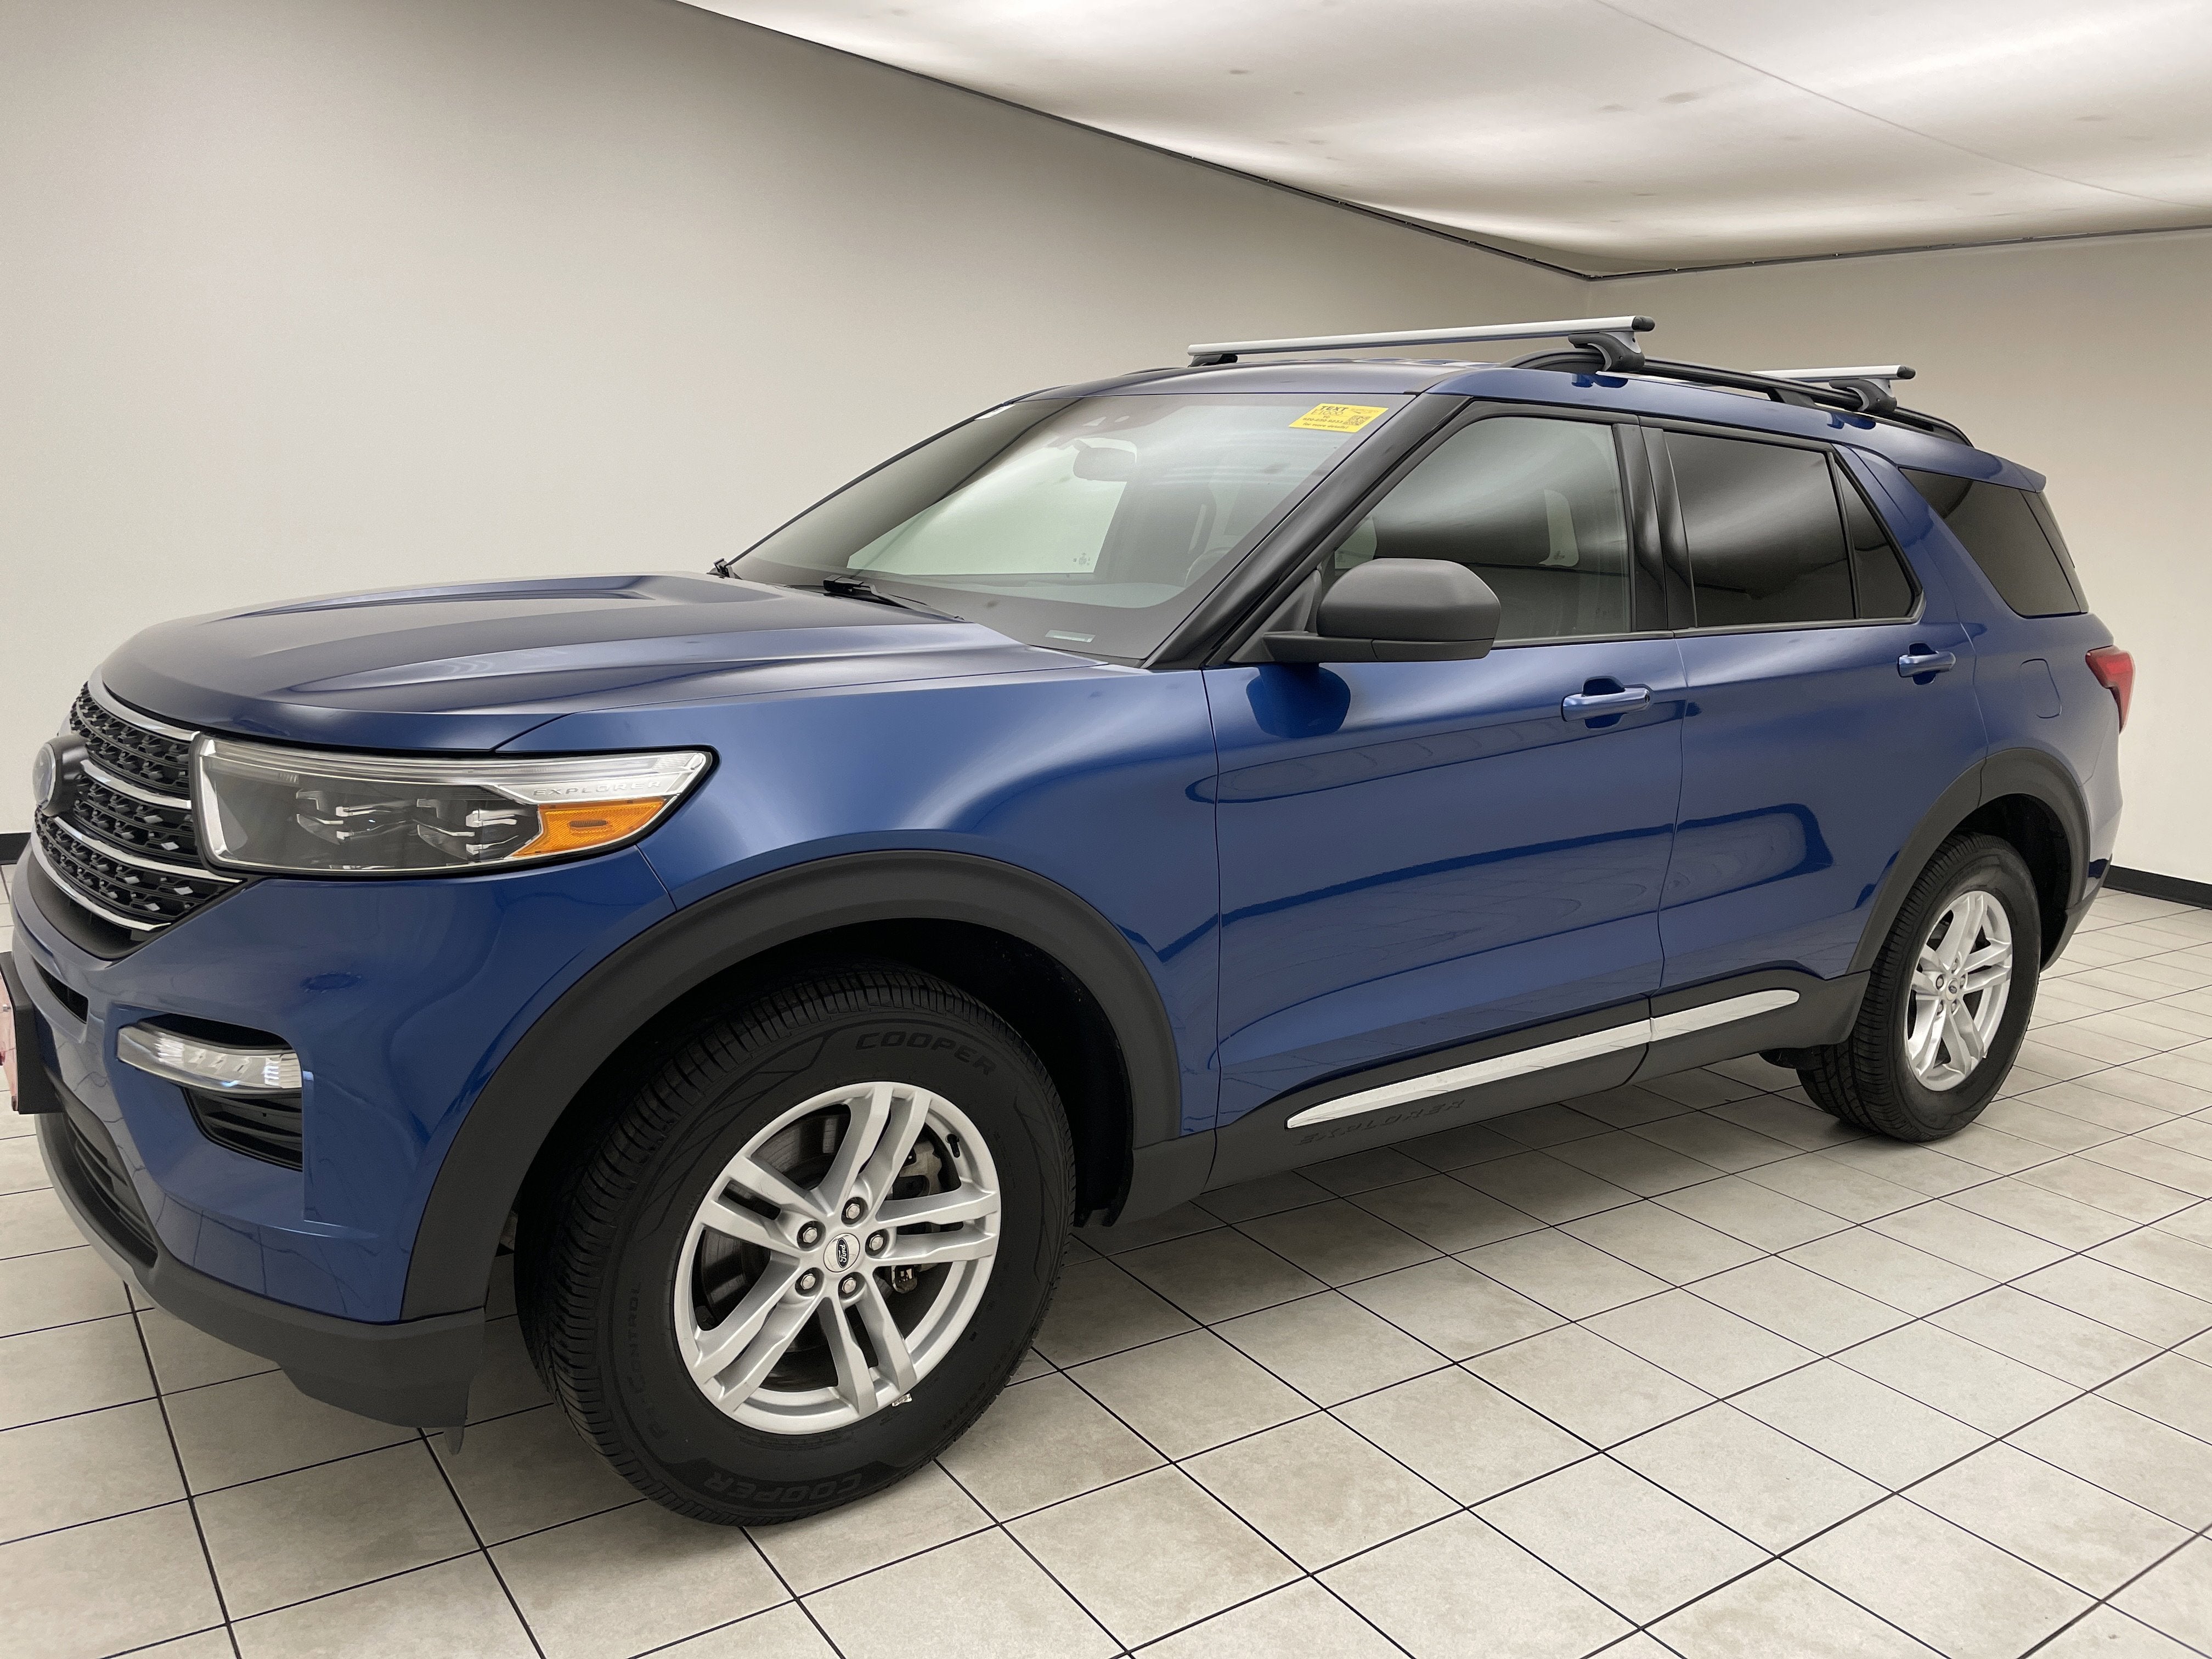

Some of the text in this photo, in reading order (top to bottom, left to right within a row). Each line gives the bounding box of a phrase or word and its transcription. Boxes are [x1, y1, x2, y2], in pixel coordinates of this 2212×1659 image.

[533, 781, 661, 795] EXPLORER
[856, 1031, 997, 1076] COOPER
[838, 1244, 847, 1263] Ford
[704, 1472, 862, 1503] COOPER
